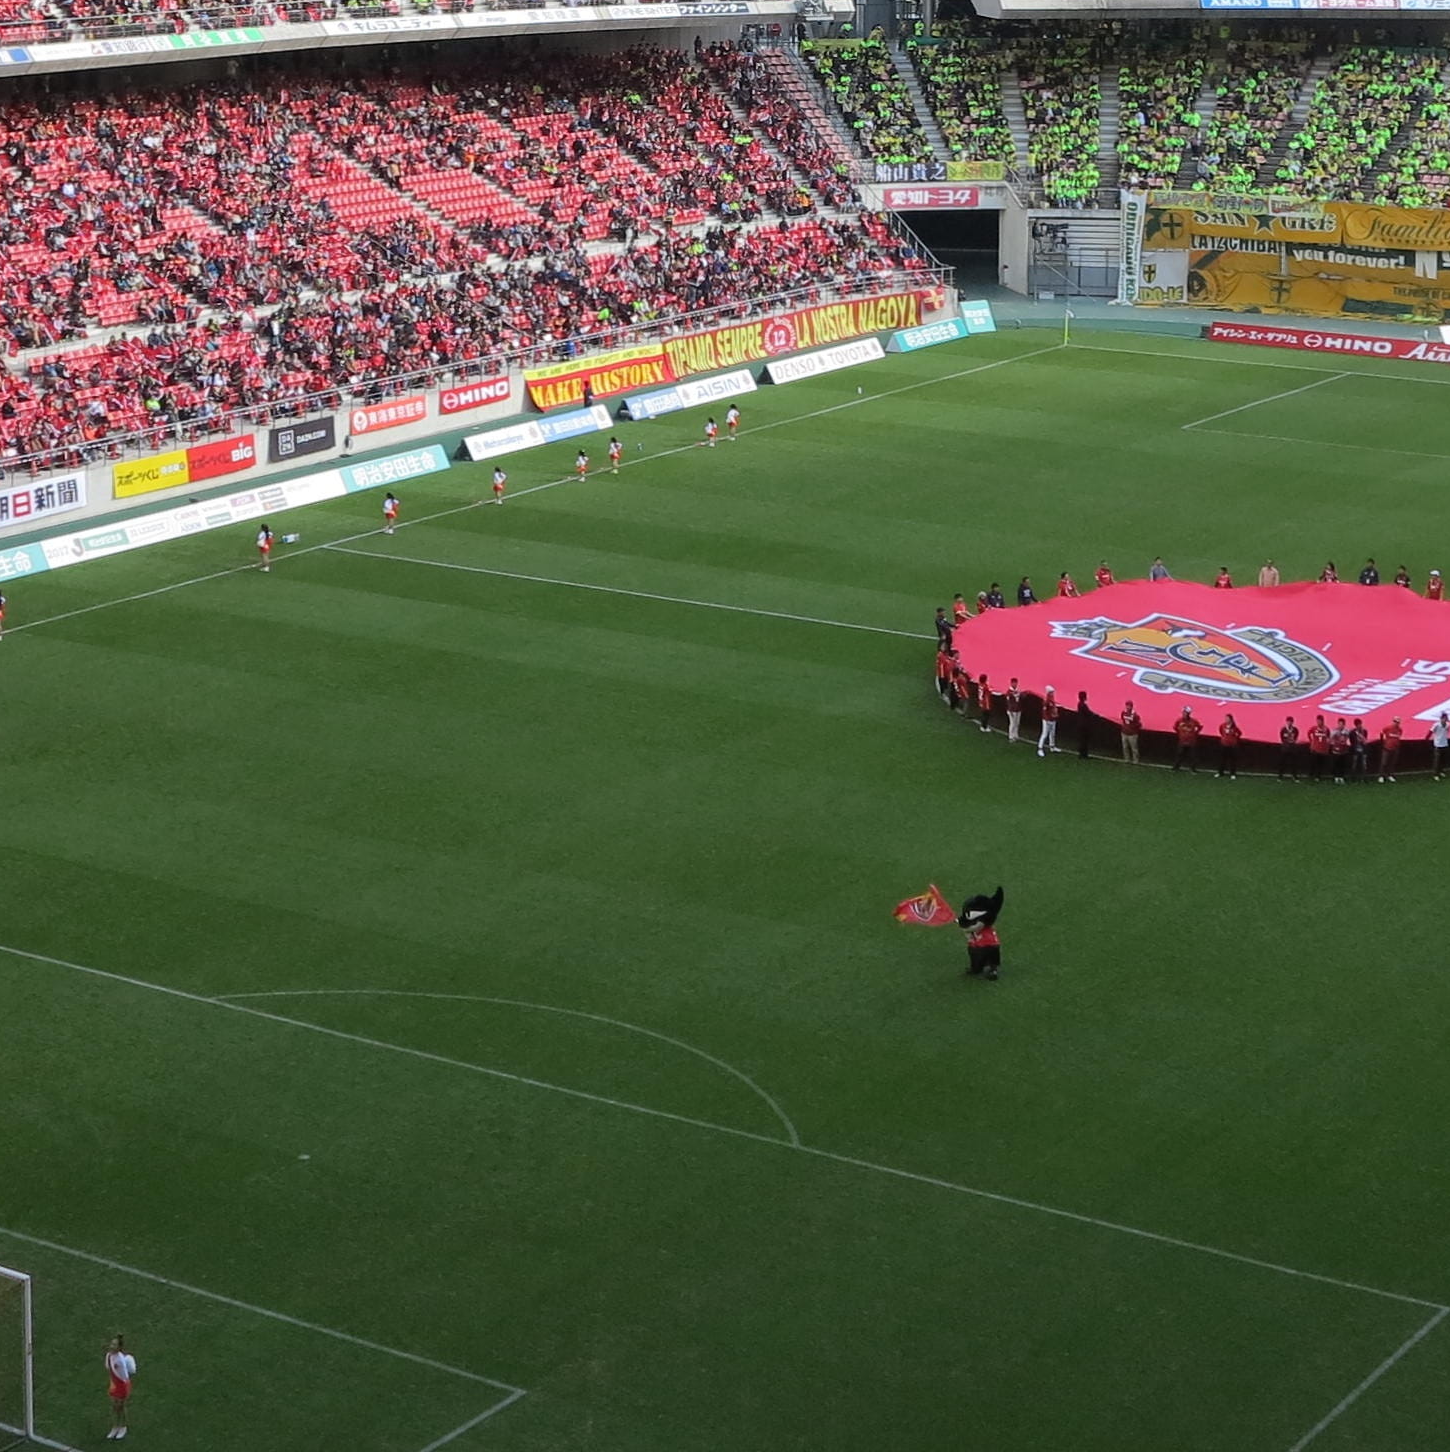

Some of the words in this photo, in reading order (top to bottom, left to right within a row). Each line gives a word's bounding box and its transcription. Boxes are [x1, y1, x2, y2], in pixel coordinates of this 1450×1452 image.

[679, 4, 747, 14] ファインシンター
[889, 188, 973, 207] 愛知トヨタ
[1292, 247, 1326, 264] you
[1328, 251, 1406, 272] forever!
[716, 324, 763, 366] SEMPRE
[773, 331, 786, 345] 12
[796, 312, 811, 344] LA
[812, 303, 860, 342] NOSTRA
[862, 294, 918, 333] NAGOYA
[1324, 338, 1393, 354] HINO
[774, 353, 816, 380] DENSO
[828, 342, 870, 368] TOYOTA
[458, 382, 509, 406] HINO
[530, 378, 583, 408] MAKE
[589, 358, 666, 397] HISTORY
[695, 379, 741, 399] AISIN
[231, 441, 253, 462] BIG
[352, 452, 438, 486] 明治安田生命
